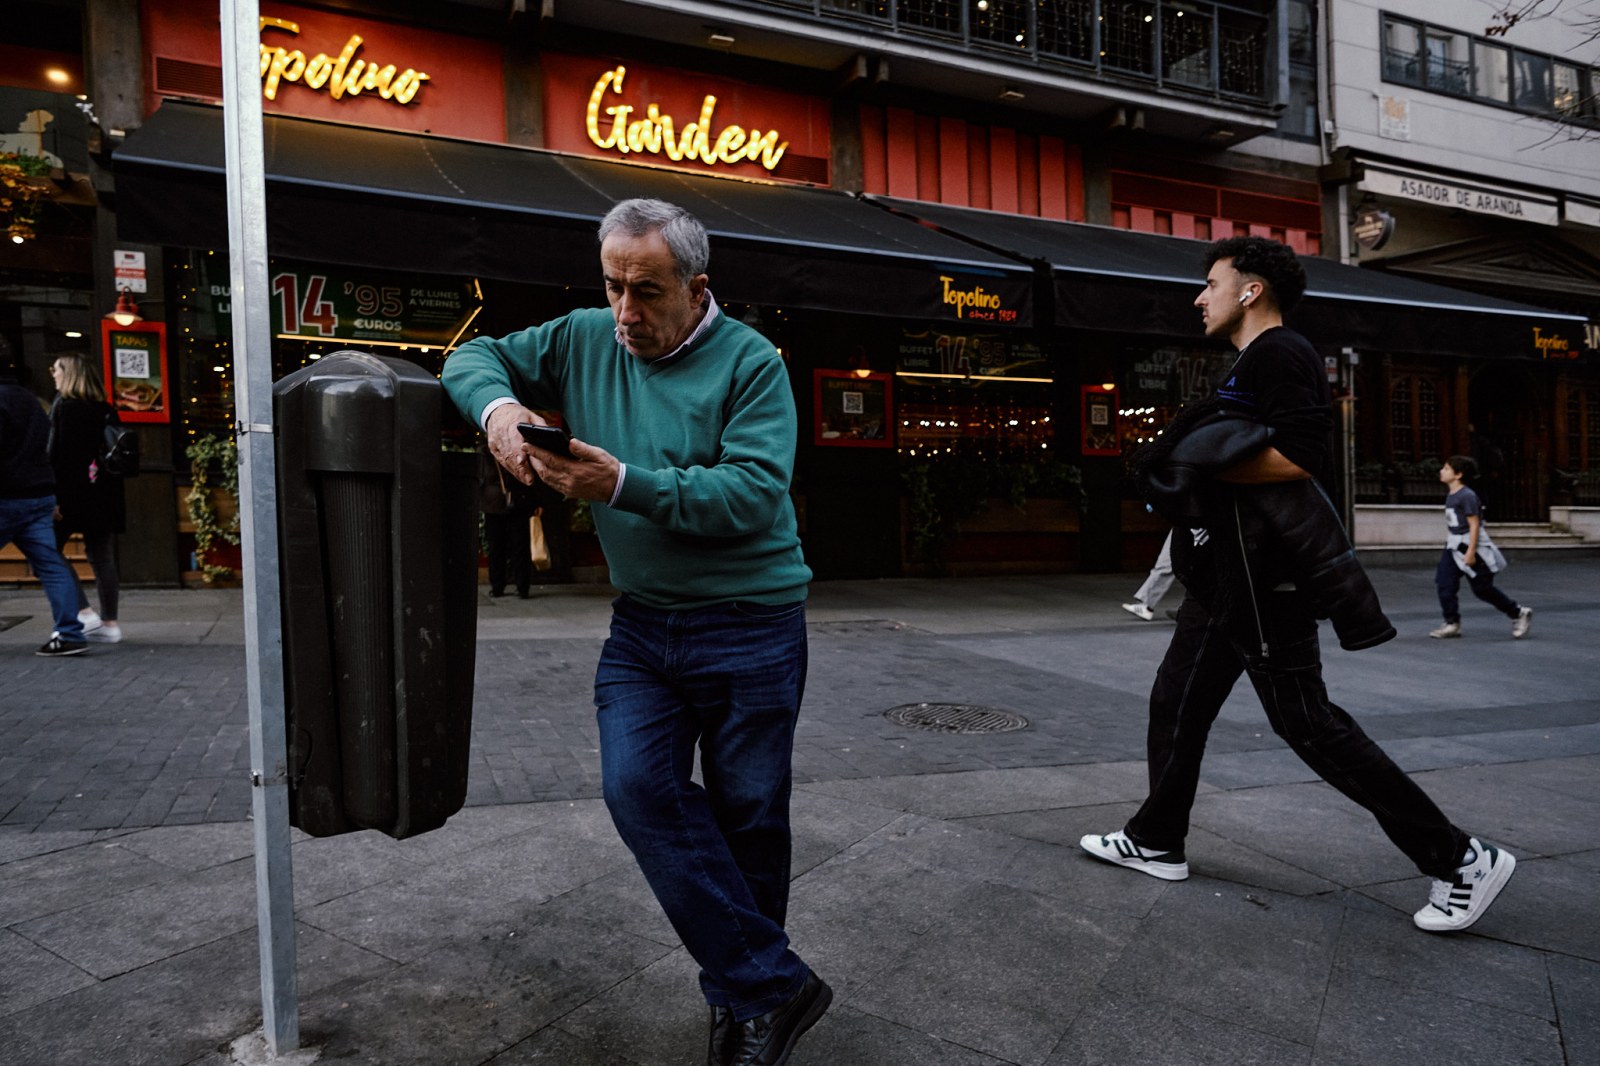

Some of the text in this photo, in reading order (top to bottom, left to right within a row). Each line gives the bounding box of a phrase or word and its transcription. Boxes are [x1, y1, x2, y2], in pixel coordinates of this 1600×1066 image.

[586, 65, 789, 170] Garden
[1400, 180, 1524, 216] ASADOR DE ARANDA
[410, 288, 460, 300] DE LUNES
[939, 275, 1001, 319] Topolino
[272, 272, 339, 337] 14
[418, 299, 462, 309] VIERNES
[115, 335, 148, 347] TAPAS
[899, 344, 934, 355] BUFFET
[903, 358, 931, 368] LIBRE
[1134, 362, 1173, 374] BUFFET
[1139, 377, 1167, 390] LIBRE
